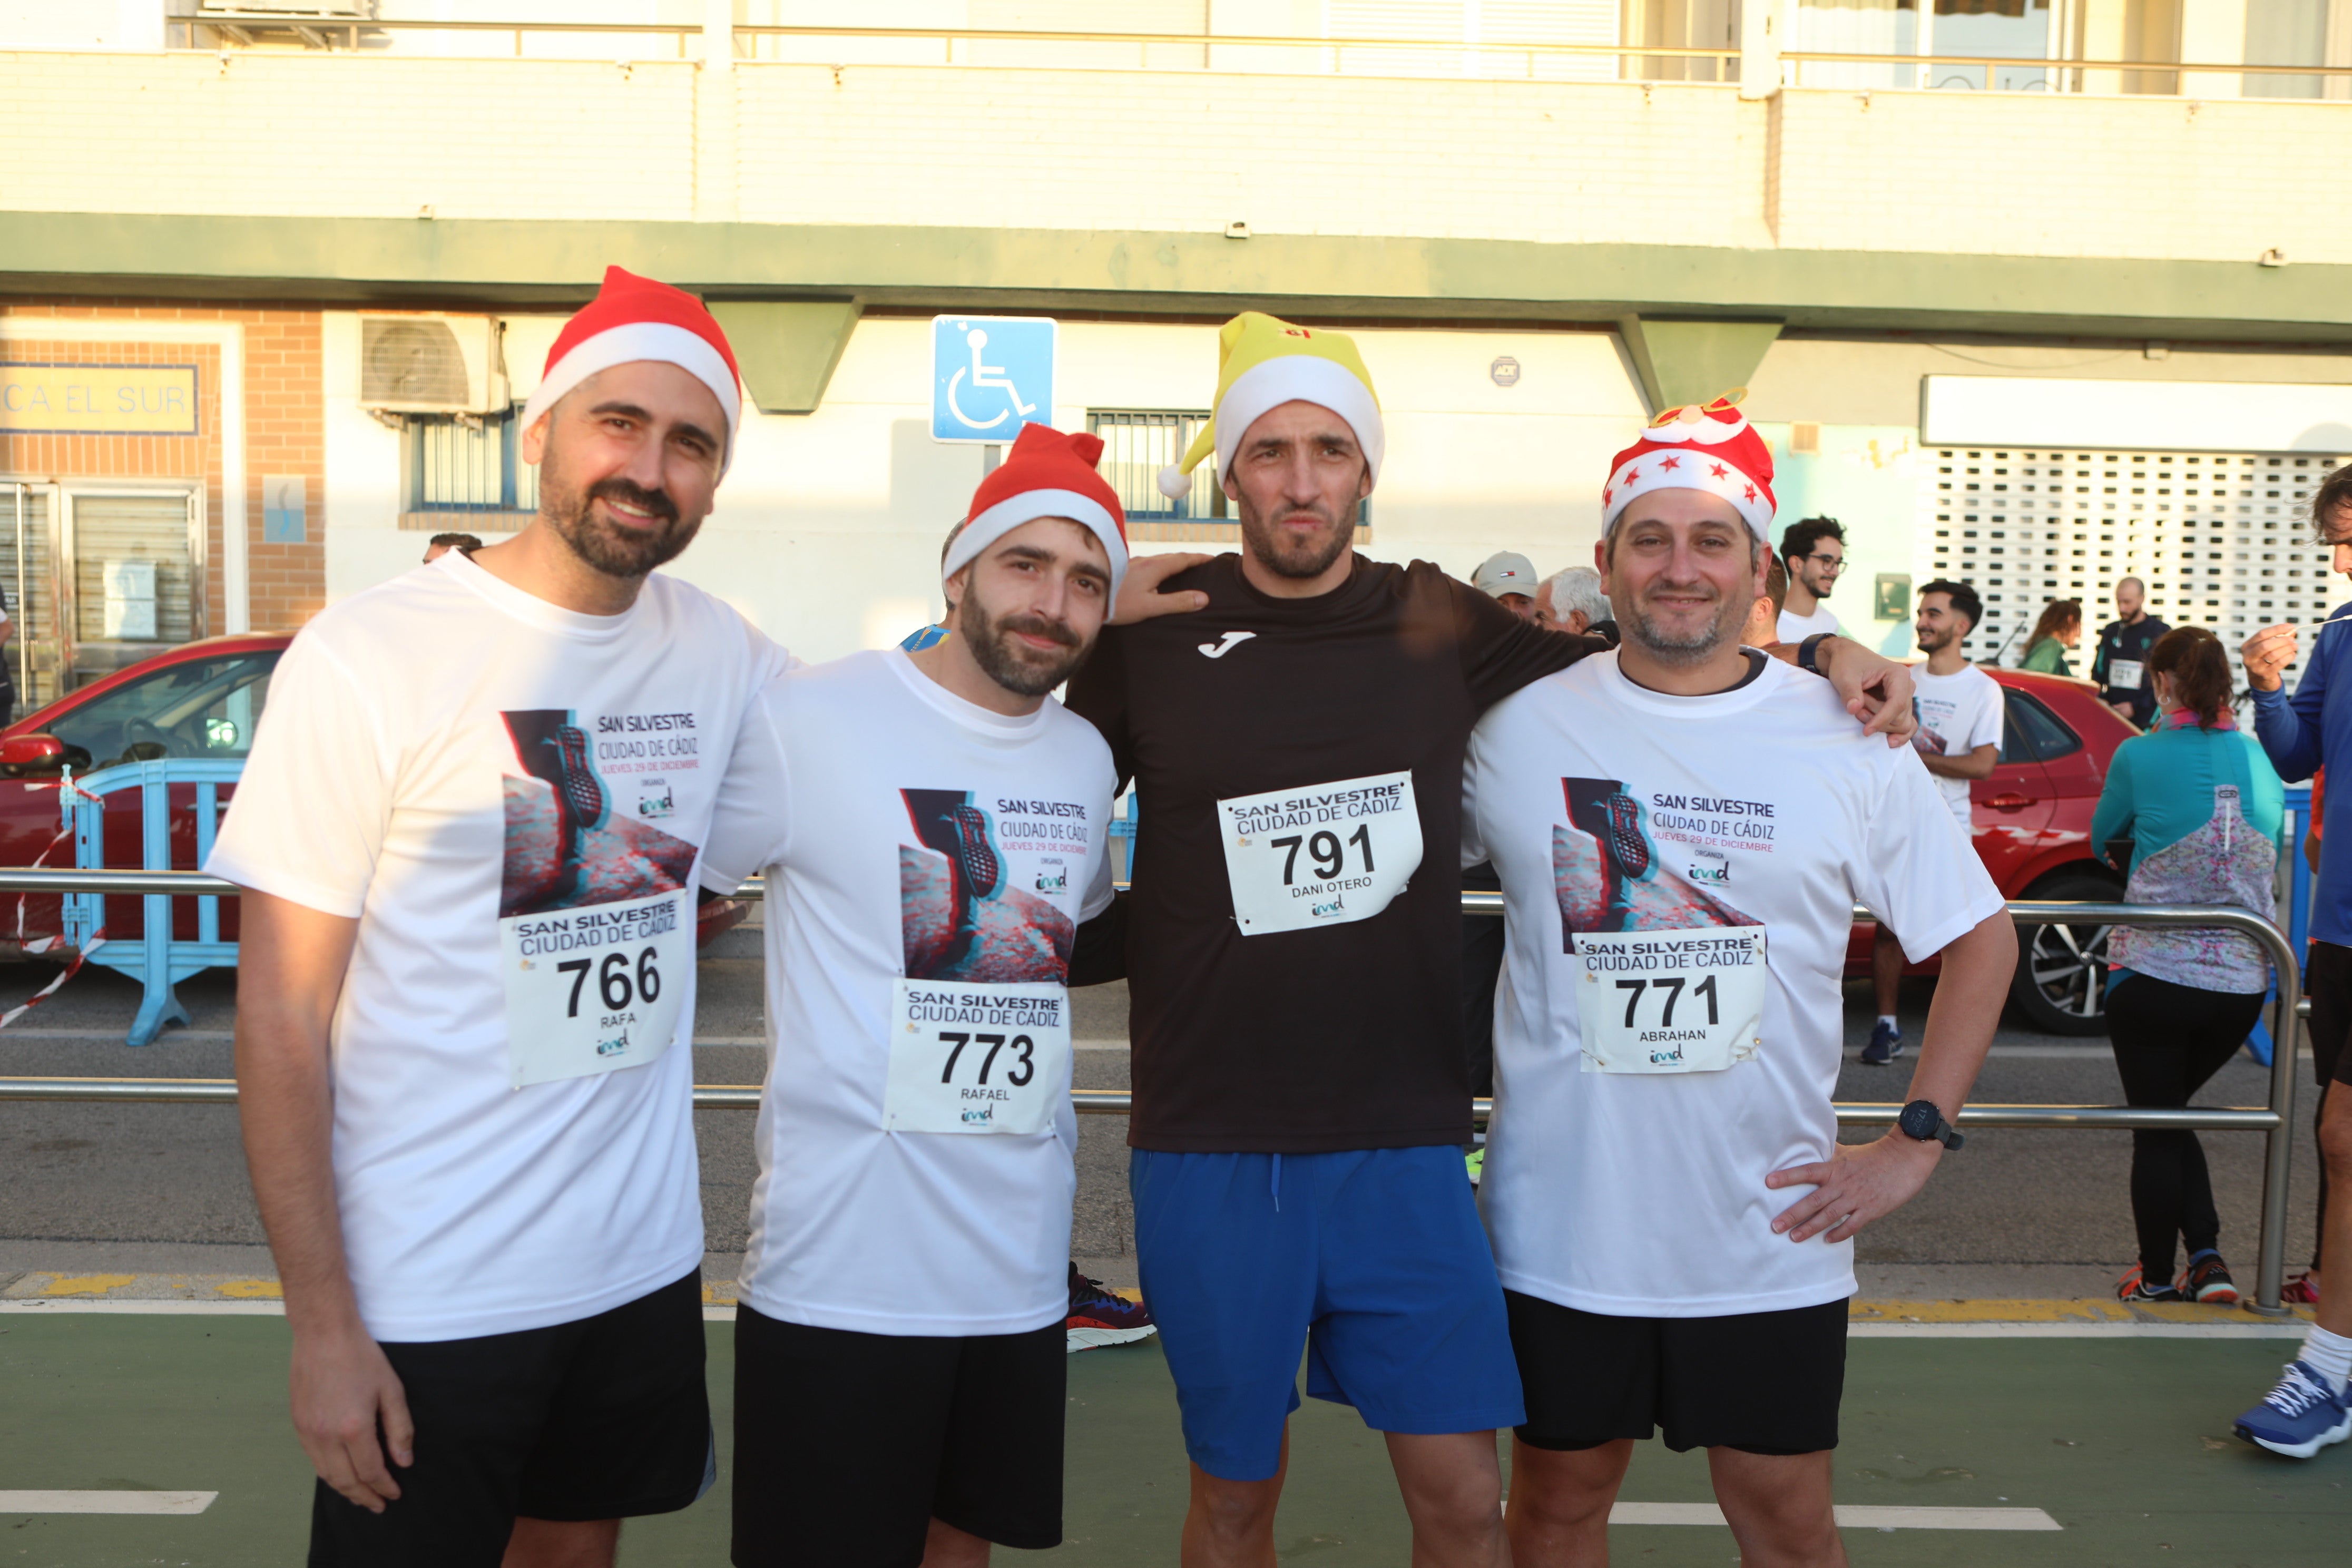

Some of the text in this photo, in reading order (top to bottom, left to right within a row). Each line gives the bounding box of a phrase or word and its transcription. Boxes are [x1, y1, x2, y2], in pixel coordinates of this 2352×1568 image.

[0, 384, 184, 414] CA EL SUR
[598, 712, 696, 732] SAN SILVESTRE
[599, 741, 646, 760] CIUDAD
[648, 739, 665, 757] DE
[601, 763, 632, 775] JUEVES
[634, 762, 645, 772] 29
[647, 761, 658, 771] DE
[998, 799, 1086, 820] SAN SILVESTRE
[1234, 783, 1400, 820] SAN SILVESTRE
[1653, 793, 1775, 818] SAN SILVESTRE
[1001, 821, 1047, 838] CIUDAD
[1050, 824, 1064, 839] DE
[1238, 810, 1311, 835] CIUDAD
[1317, 806, 1342, 822] DE
[1654, 812, 1775, 840] CIUDAD DE CÁDIZ
[1002, 842, 1033, 850] JUEVES
[1035, 842, 1046, 851] 29
[1048, 843, 1057, 851] DE
[1653, 831, 1773, 852] JUEVES 29 DE DICIEMBRE
[1271, 824, 1375, 885] 791
[1695, 849, 1724, 859] ORGANIZA
[1292, 877, 1372, 898] DANI OTERO
[518, 900, 675, 937] SAN SILVESTRE
[521, 929, 602, 956] CIUDAD
[607, 924, 633, 944] DE
[1585, 938, 1752, 955] SAN SILVESTRE
[1586, 955, 1658, 971] CIUDAD
[1665, 954, 1690, 968] DE
[557, 946, 661, 1017] 766
[908, 992, 1059, 1011] SAN SILVESTRE
[1616, 975, 1719, 1028] 771
[601, 1012, 636, 1028] RAFA
[909, 1005, 983, 1024] CIUDAD
[989, 1010, 1012, 1025] DE
[1640, 1030, 1706, 1042] ABRAHAN
[939, 1032, 1034, 1086] 773
[961, 1089, 1010, 1101] RAFAEL
